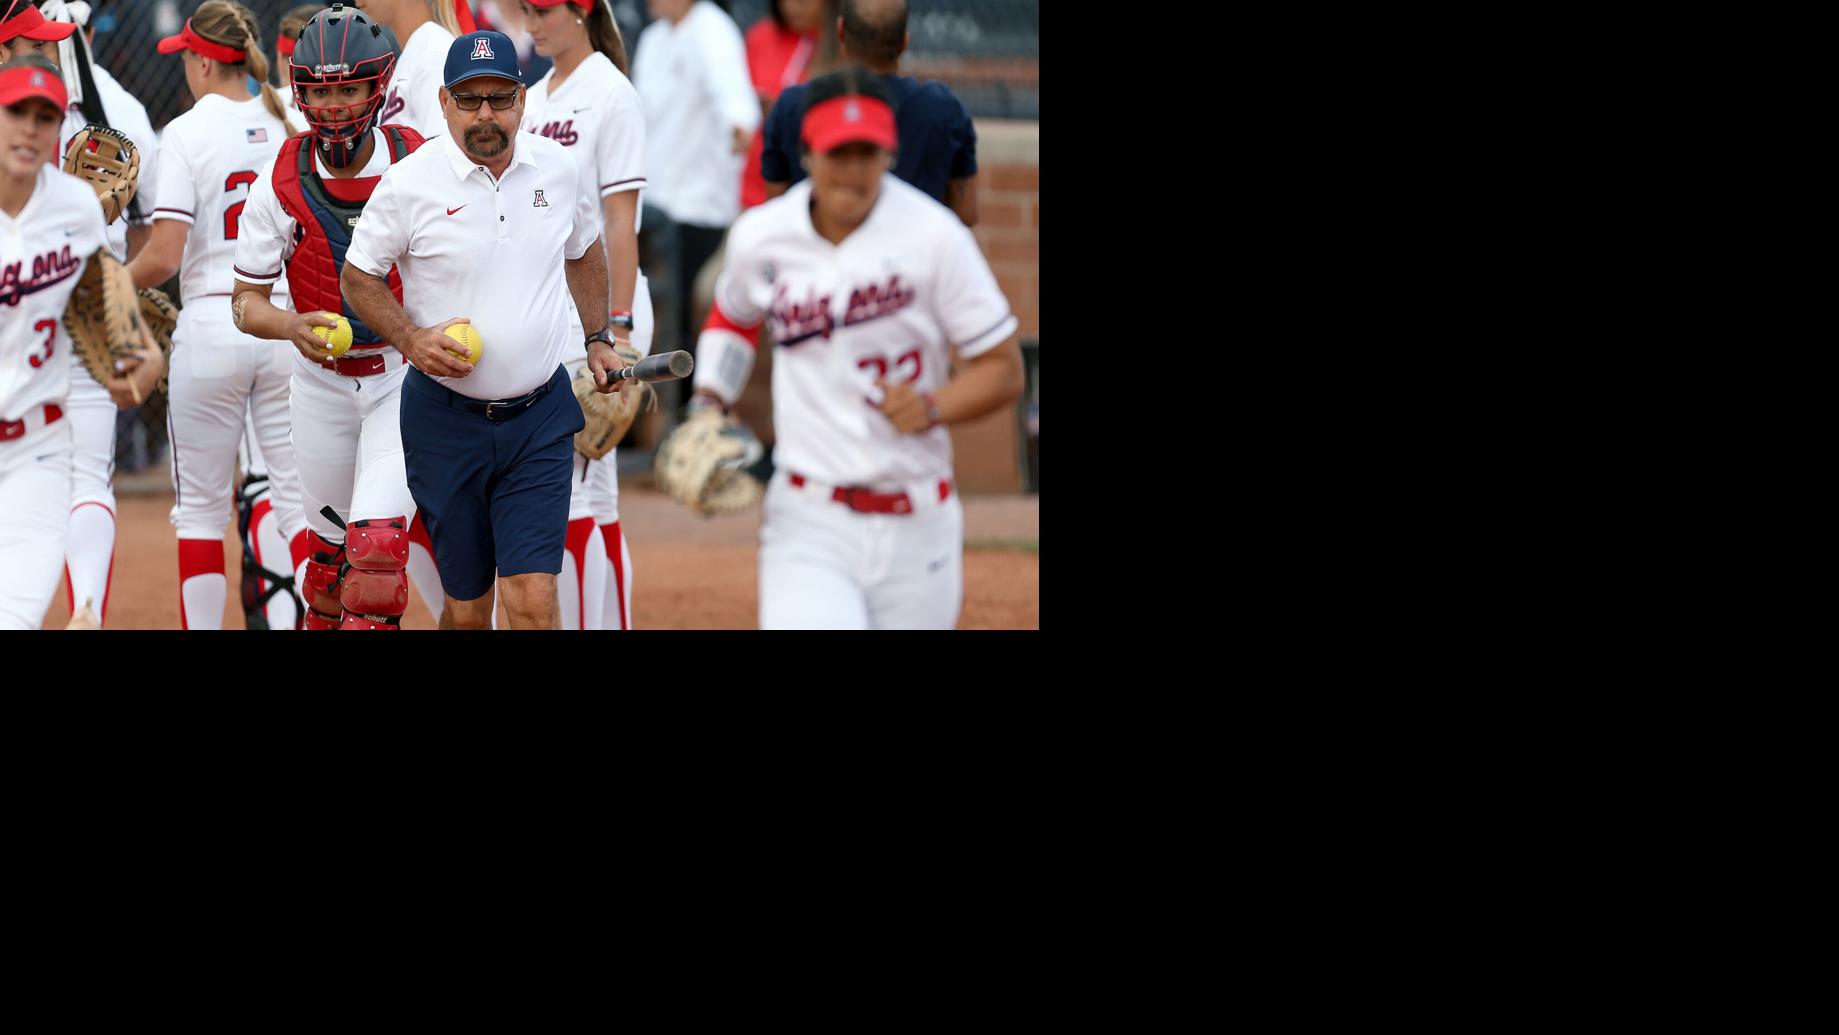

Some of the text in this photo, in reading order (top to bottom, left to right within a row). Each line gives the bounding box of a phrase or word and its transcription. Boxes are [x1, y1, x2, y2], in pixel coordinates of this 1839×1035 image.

[471, 38, 494, 60] A
[527, 119, 579, 147] ona
[533, 189, 548, 207] A
[0, 244, 81, 307] zona
[28, 317, 57, 368] 3
